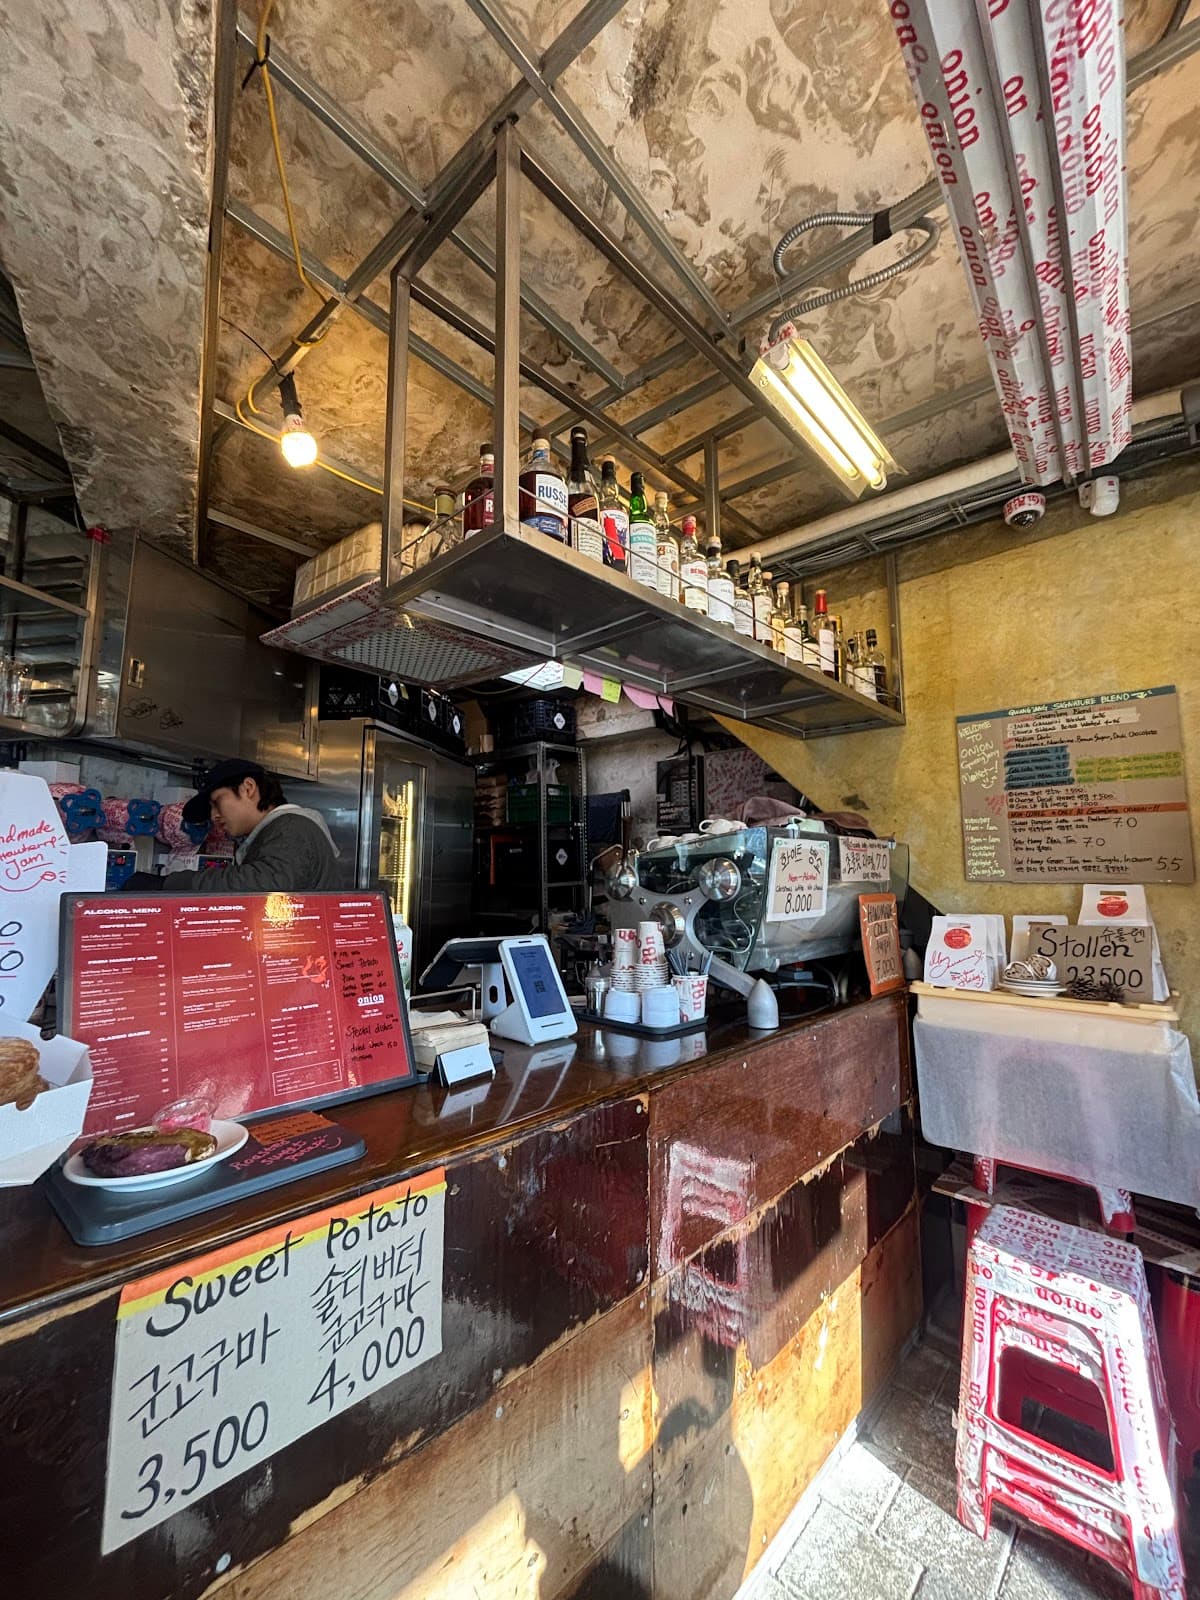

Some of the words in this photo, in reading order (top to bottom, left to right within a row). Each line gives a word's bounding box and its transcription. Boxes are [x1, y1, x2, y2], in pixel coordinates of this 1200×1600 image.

[941, 50, 982, 150] onion
[921, 102, 958, 184] onion
[1083, 104, 1103, 196] onion
[959, 226, 987, 287] onion
[1101, 693, 1130, 704] BLEND
[961, 741, 993, 758] ONION
[966, 733, 982, 742] TO
[5, 854, 43, 880] Jam
[1038, 928, 1134, 958] Stollen
[1100, 926, 1145, 943] 슈톨렌
[358, 993, 384, 1005] onion
[1006, 1208, 1060, 1231] onion
[146, 1230, 304, 1337] Sweet
[325, 1187, 428, 1259] Potato
[973, 1287, 986, 1343] onion
[1035, 1286, 1103, 1319] onion
[127, 1312, 281, 1439] 군고구마
[318, 1280, 431, 1354] 군고구마
[120, 1400, 269, 1520] 3,500
[307, 1315, 425, 1412] 4,000
